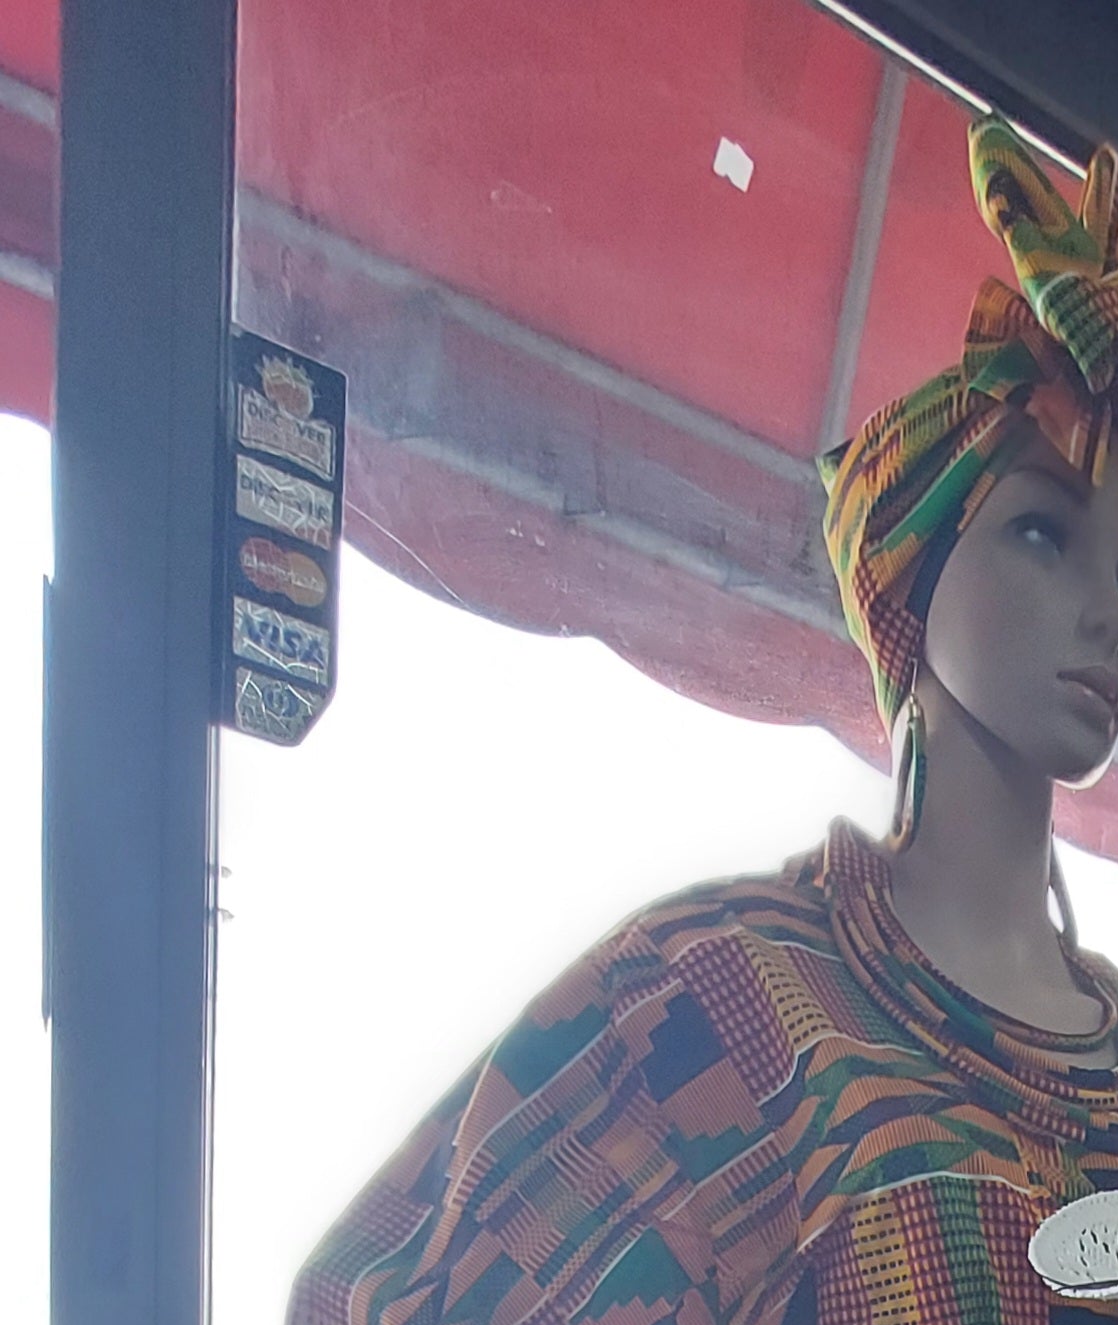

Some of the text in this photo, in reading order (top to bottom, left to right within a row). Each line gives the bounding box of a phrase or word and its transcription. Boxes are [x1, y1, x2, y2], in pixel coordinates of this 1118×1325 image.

[247, 401, 326, 443] DISCVER
[240, 474, 329, 522] DISCVER
[241, 614, 325, 669] VISA
